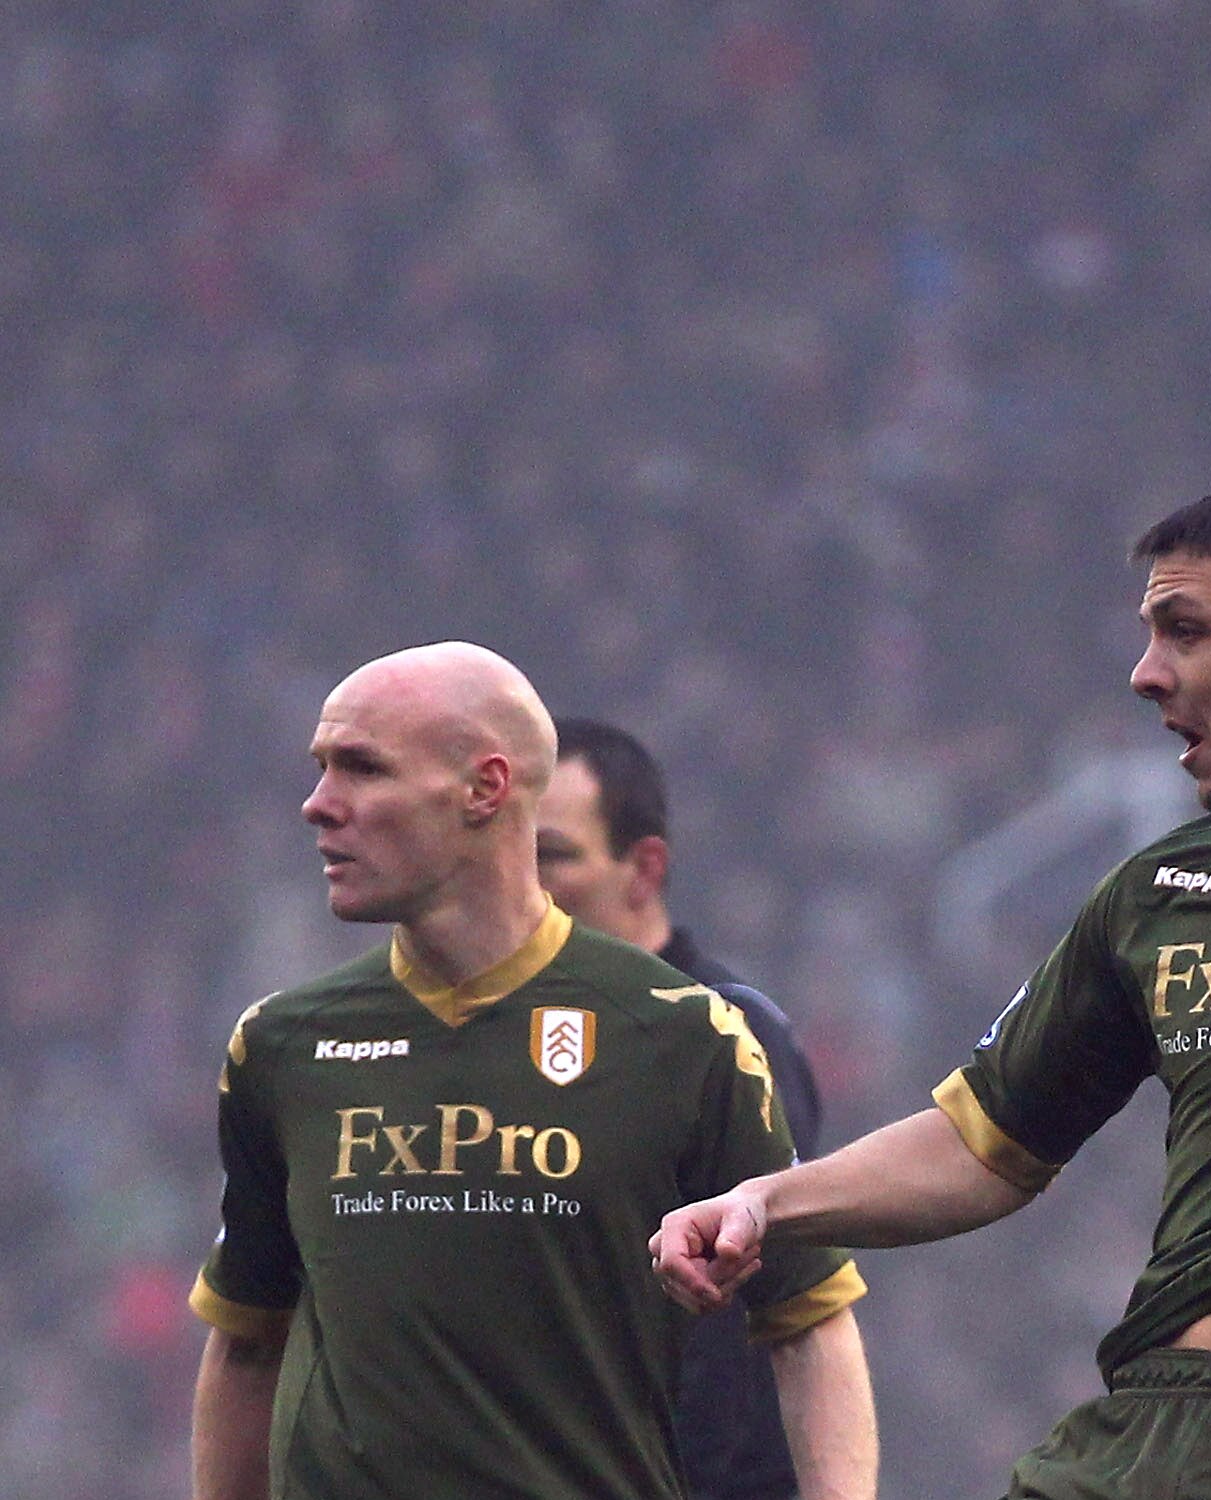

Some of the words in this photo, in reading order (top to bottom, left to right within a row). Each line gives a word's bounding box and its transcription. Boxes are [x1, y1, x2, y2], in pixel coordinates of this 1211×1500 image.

[314, 1037, 410, 1062] Kappa
[330, 1103, 582, 1180] FxPro
[332, 1192, 385, 1216] Trade
[388, 1190, 455, 1213] Forex
[463, 1190, 515, 1213] Like
[521, 1194, 535, 1214] a
[542, 1191, 581, 1216] Pro
